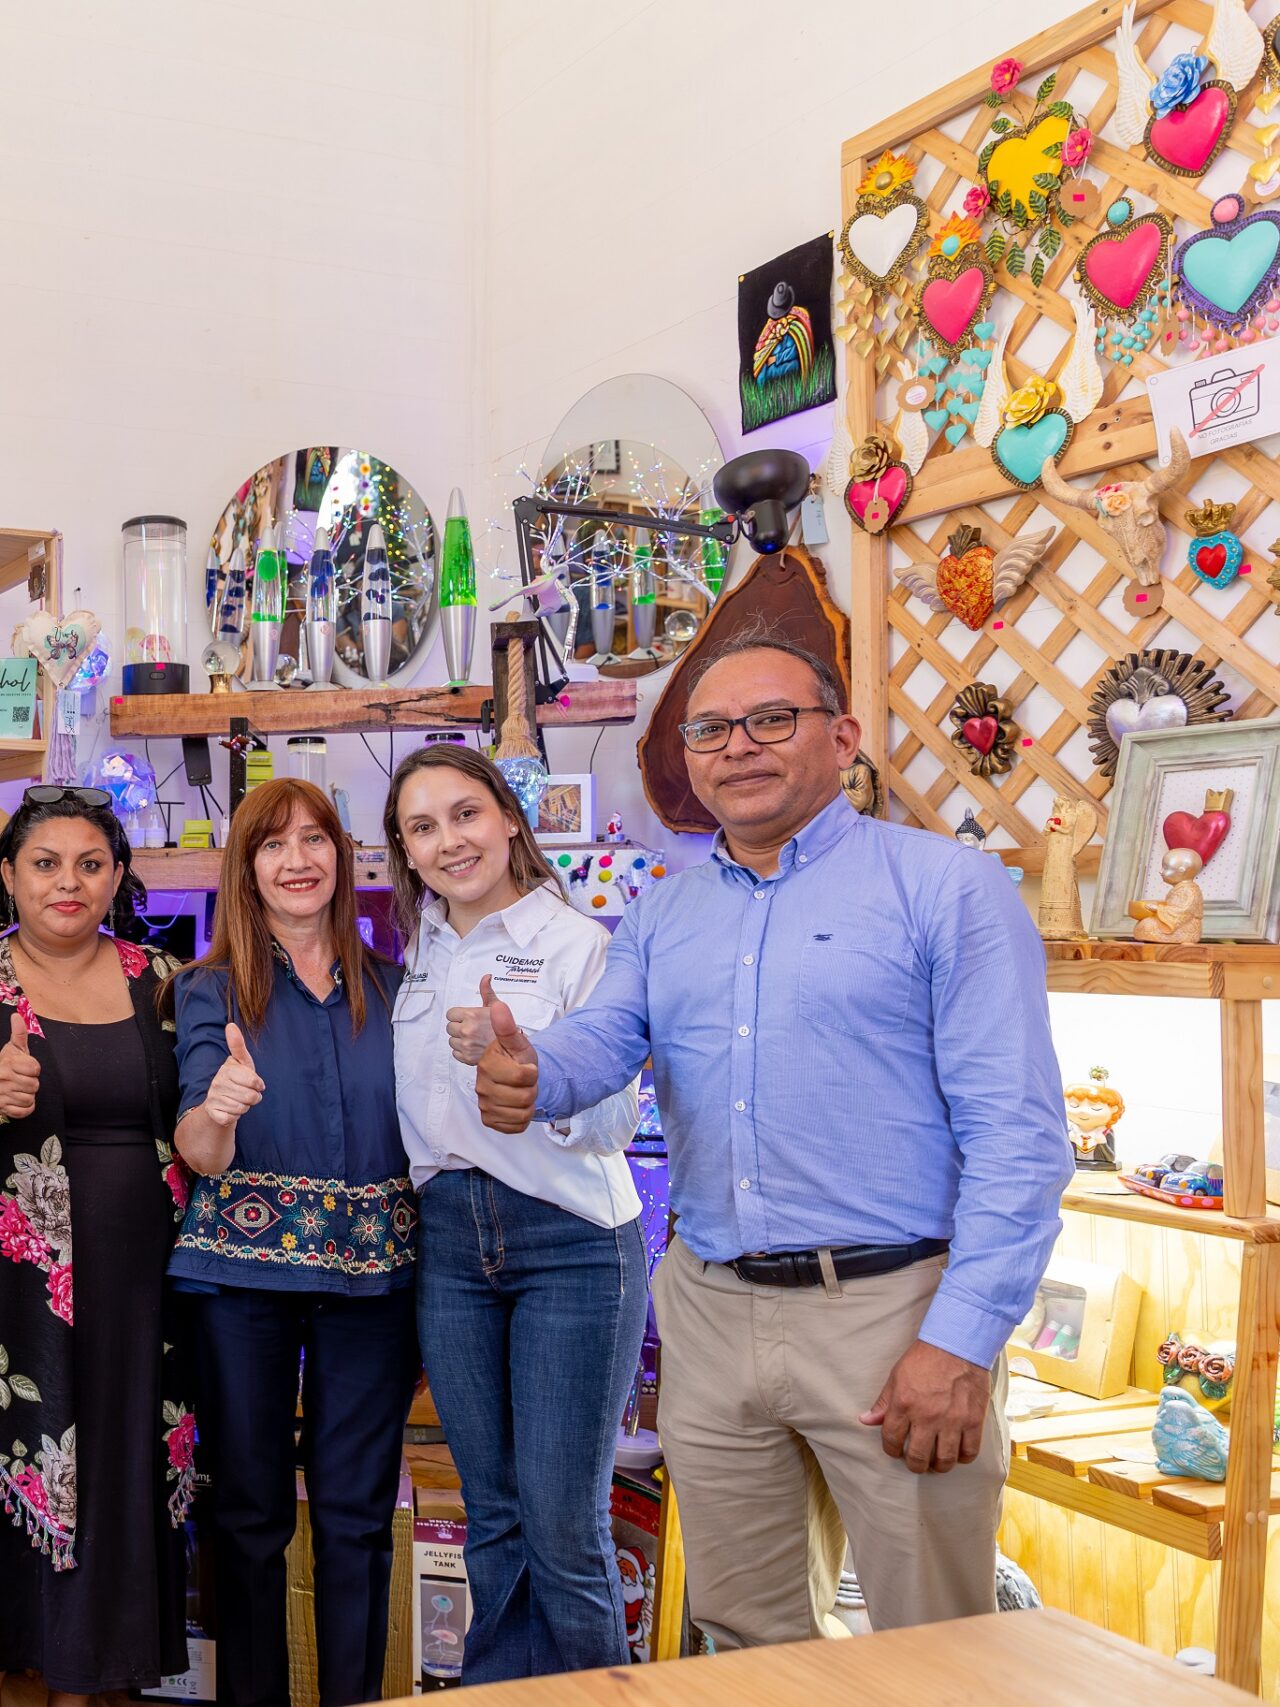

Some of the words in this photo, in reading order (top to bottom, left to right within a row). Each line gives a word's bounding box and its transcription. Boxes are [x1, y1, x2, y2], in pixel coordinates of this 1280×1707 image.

[495, 954, 545, 966] CUIDEMOS
[423, 1551, 463, 1559] JELLYFIS
[433, 1560, 456, 1568] TANK
